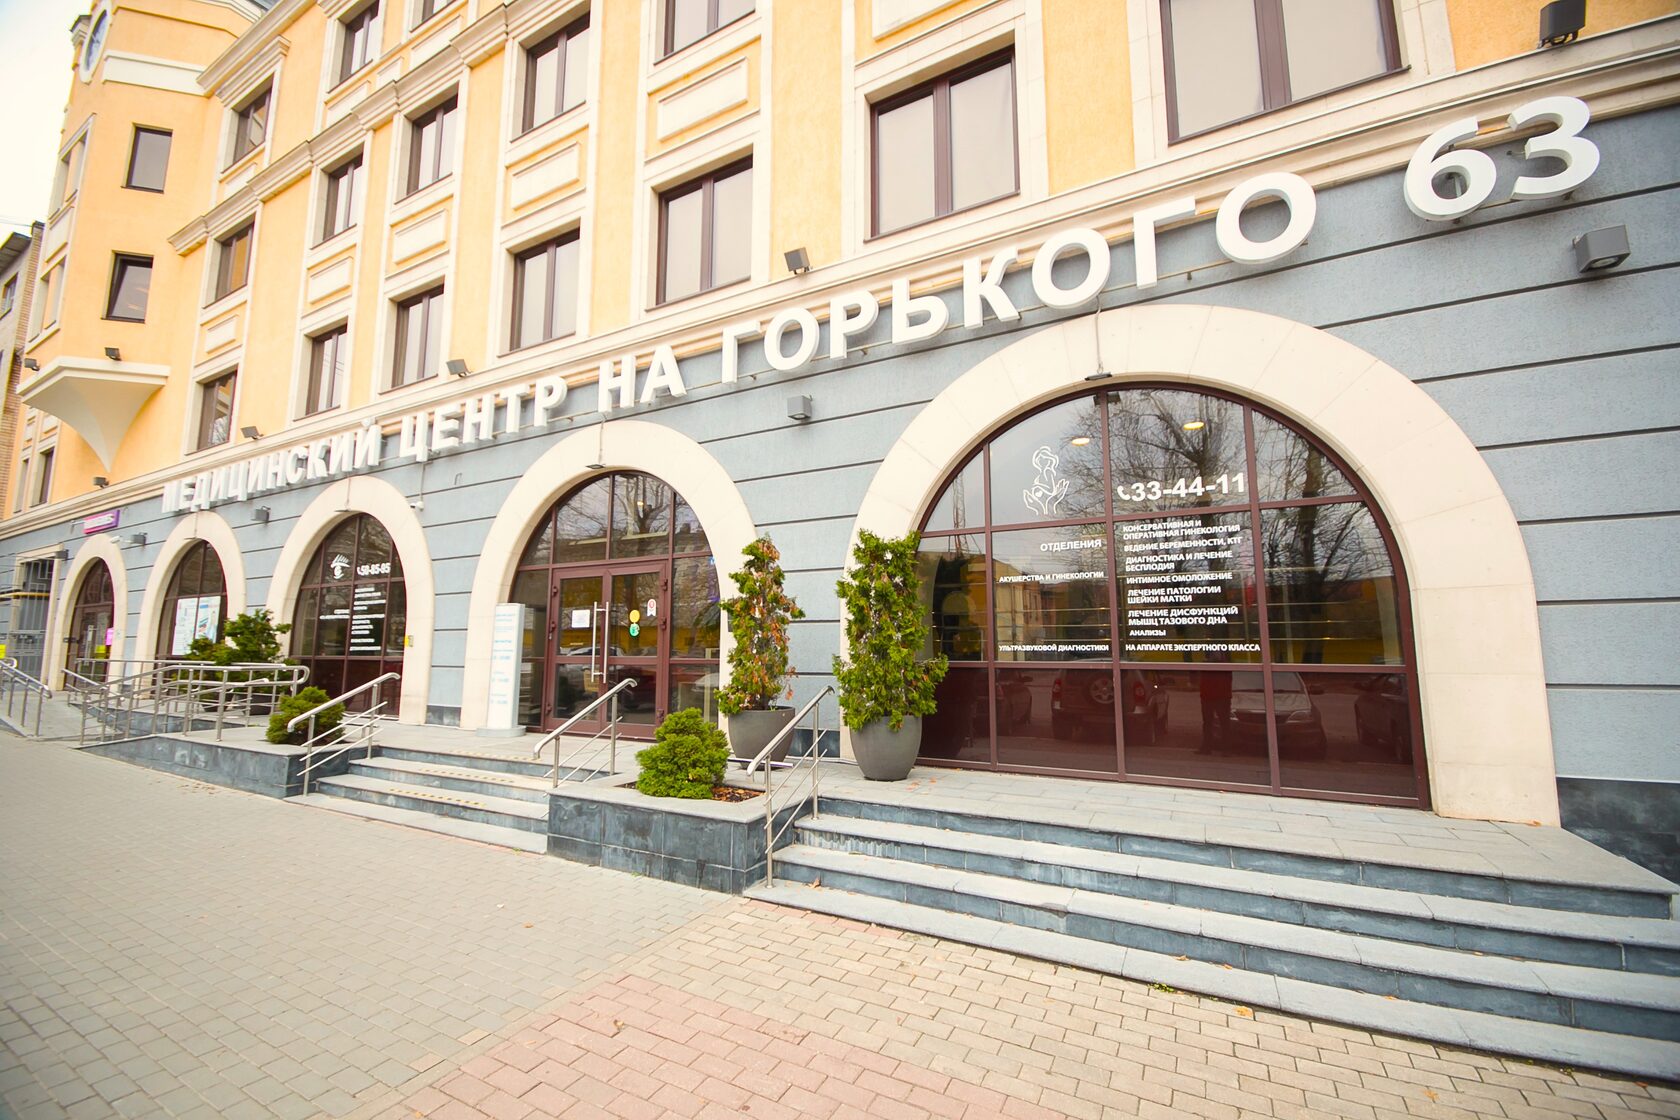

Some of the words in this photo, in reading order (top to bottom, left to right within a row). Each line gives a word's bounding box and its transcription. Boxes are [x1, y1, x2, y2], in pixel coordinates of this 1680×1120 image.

[161, 417, 383, 513] МЕДИЦИНСКИЙ
[400, 375, 568, 462] ЦЕНТР
[597, 343, 688, 413] НА
[720, 171, 1317, 384] ГОРЬКОГО
[1403, 95, 1602, 224] 63
[1131, 472, 1245, 502] 33-44-11
[1123, 520, 1195, 533] КОНСЕРВАТИВНАЯ
[1123, 529, 1180, 540] ОПЕРАТИВНАЯ
[1180, 524, 1241, 536] ГИНЕКОЛОГИЯ
[1040, 539, 1102, 553] ОТДЕЛЕНИЯ
[1124, 543, 1159, 552] ВЕДЕНИЕ
[1227, 536, 1243, 545] КТГ
[1126, 554, 1185, 565] ДИАГНОСТИКА
[1194, 551, 1233, 560] ЛЕЧЕНИЕ
[1126, 562, 1175, 572] БЕСПЛОДИЯ
[999, 574, 1044, 583] АКУШЕРСТВА
[1052, 571, 1104, 580] ГИНЕКОЛОГИИ
[1126, 575, 1171, 584] ИНТИМНОЕ
[1171, 572, 1233, 582] ОМОЛОЖЕНИЕ
[1128, 587, 1166, 597] ЛЕЧЕНИЕ
[1166, 586, 1222, 595] ПАТОЛОГИИ
[1127, 594, 1159, 604] ШЕЙКИ
[1160, 595, 1192, 603] МАТКИ
[1128, 608, 1169, 618] ЛЕЧЕНИЕ
[1170, 605, 1239, 617] ДИСФУНКЦИЙ
[1128, 618, 1159, 627] МЫШЦ
[1159, 617, 1206, 626] ТАЗОВОГО
[1206, 616, 1228, 626] ДНА
[1129, 629, 1167, 637] АНАЛИЗЫ
[999, 643, 1057, 652] УЛЬТРАЗВУКОВОЙ
[1058, 644, 1109, 653] ДИАГНОСТИКИ
[1136, 644, 1173, 652] АППАРАТЕ
[1173, 643, 1228, 652] ЭКСПЕРТНОГО
[1228, 643, 1261, 652] КЛАССА
